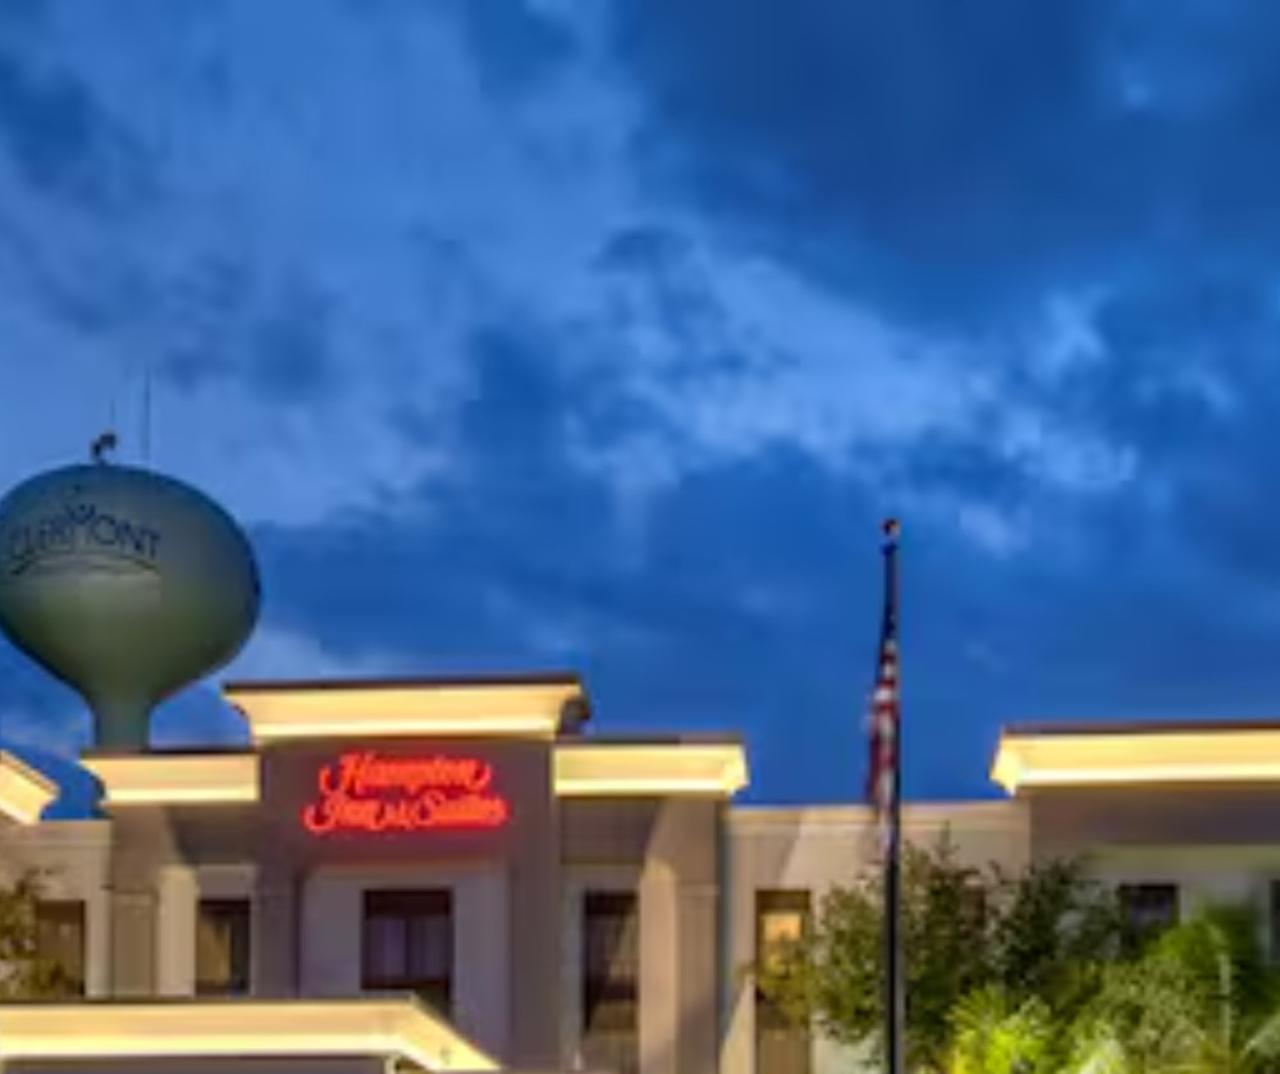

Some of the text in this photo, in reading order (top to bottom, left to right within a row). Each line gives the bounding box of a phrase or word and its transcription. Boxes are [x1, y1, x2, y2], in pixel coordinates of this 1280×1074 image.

[318, 752, 493, 795] Hampton
[302, 790, 383, 831] Inn
[415, 790, 510, 829] Suites
